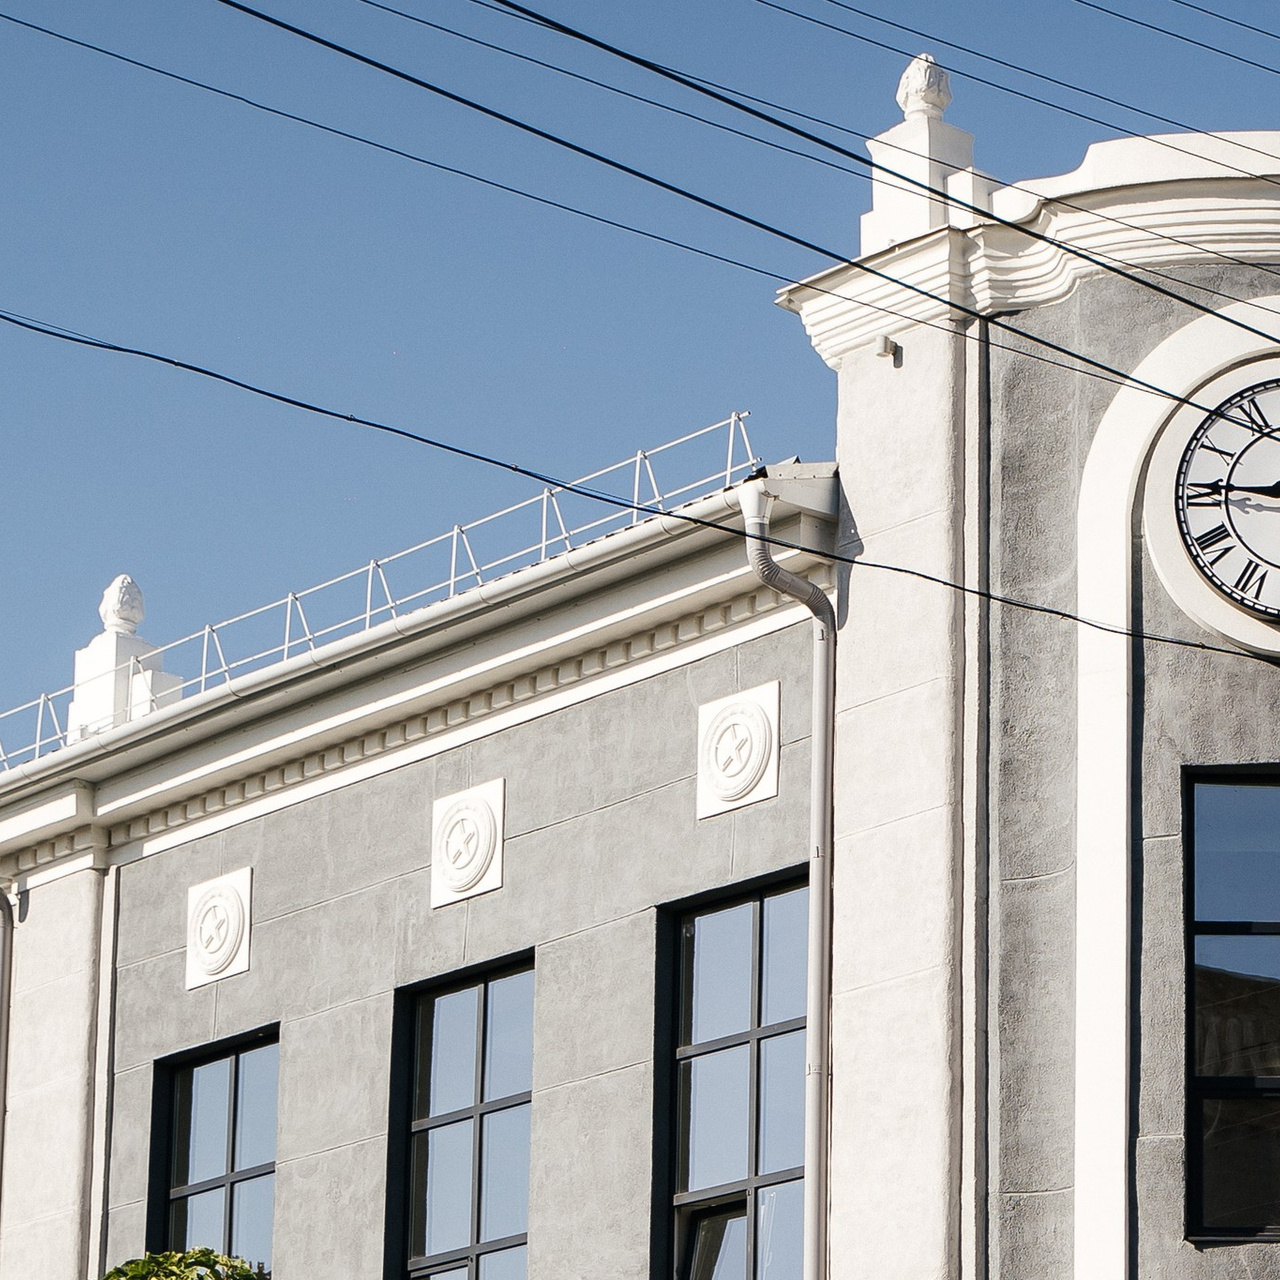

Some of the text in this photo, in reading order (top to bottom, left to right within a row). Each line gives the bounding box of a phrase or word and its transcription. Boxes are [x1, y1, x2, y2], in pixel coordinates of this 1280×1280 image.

[1234, 396, 1272, 437] XI
[1198, 435, 1236, 466] X
[1192, 521, 1236, 569] VIII
[1231, 558, 1268, 600] VII
